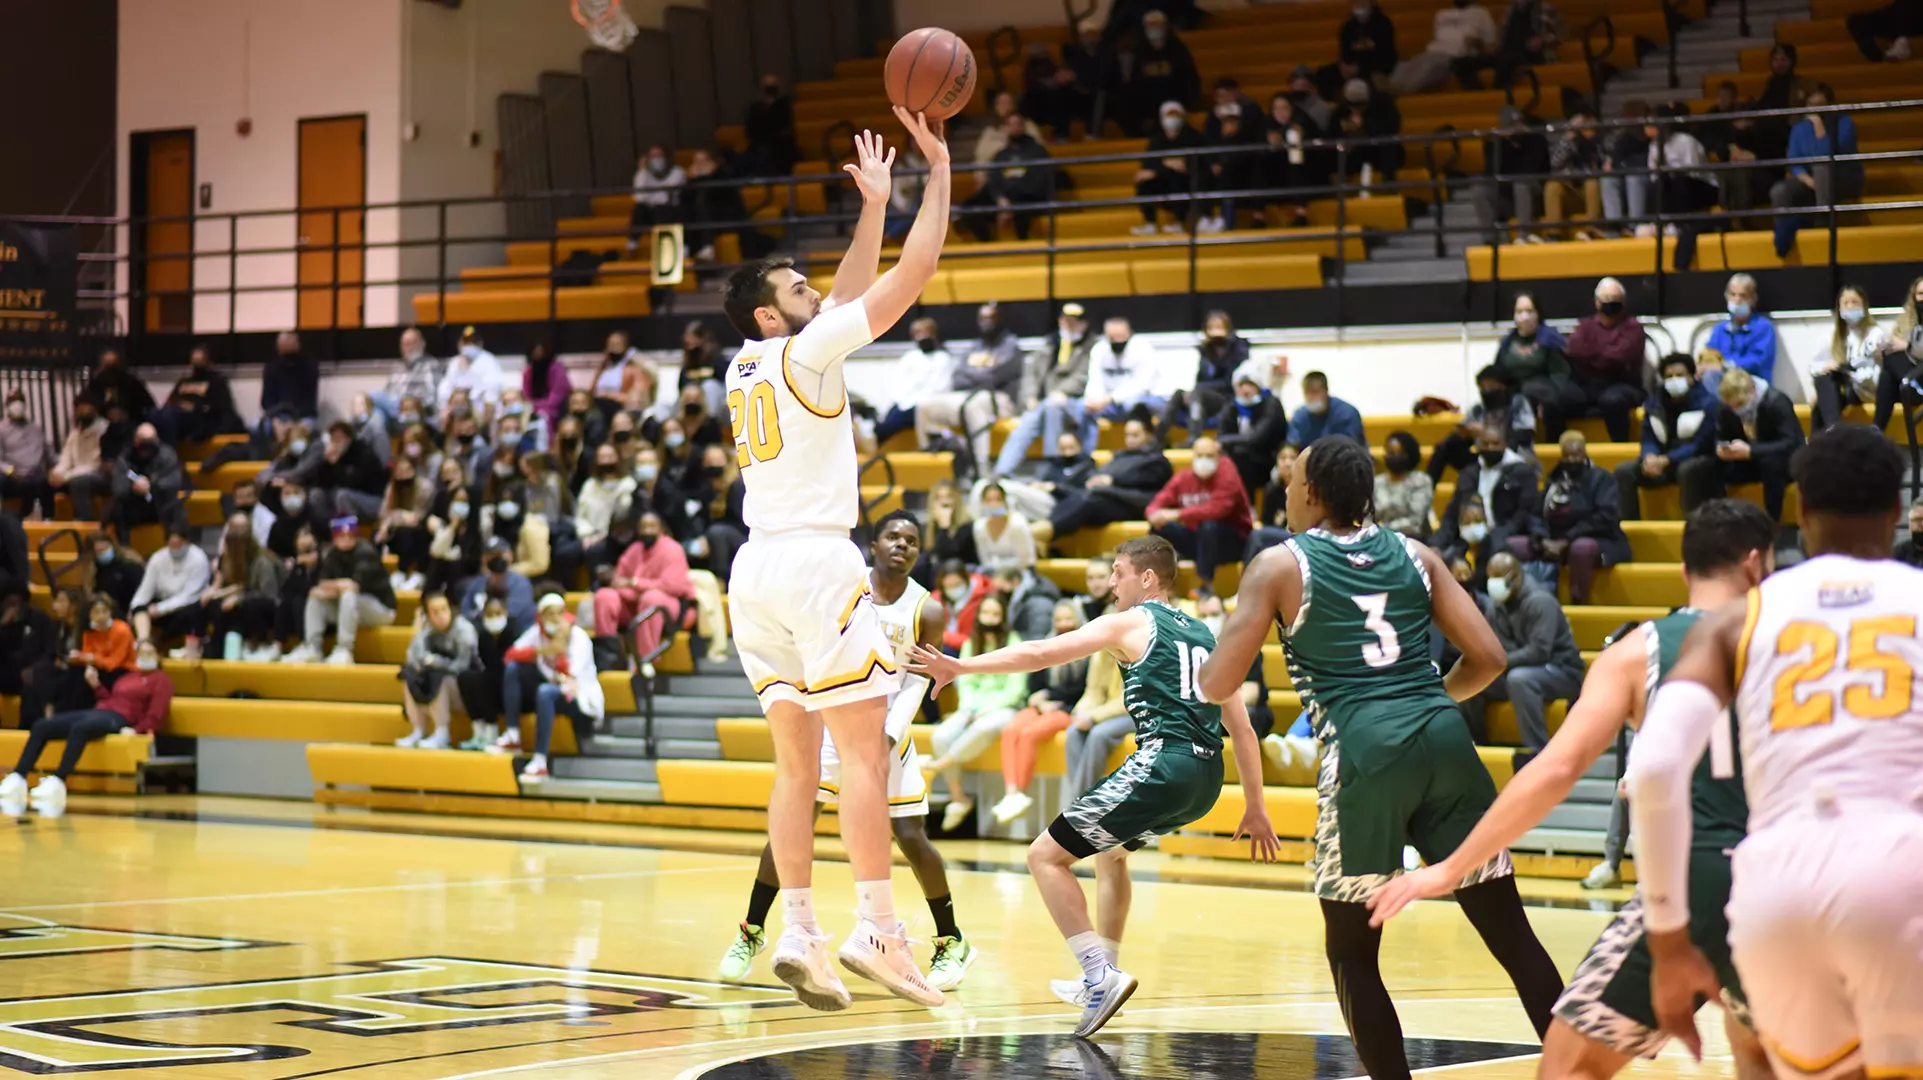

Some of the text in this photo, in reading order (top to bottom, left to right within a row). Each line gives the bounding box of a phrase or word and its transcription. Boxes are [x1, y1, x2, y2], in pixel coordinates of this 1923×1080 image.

[938, 53, 971, 107] Wilson
[658, 231, 677, 276] D
[0, 288, 47, 309] ENT
[728, 379, 784, 469] 20
[1351, 592, 1401, 668] 3
[1173, 640, 1210, 704] 10
[1769, 613, 1917, 734] 25
